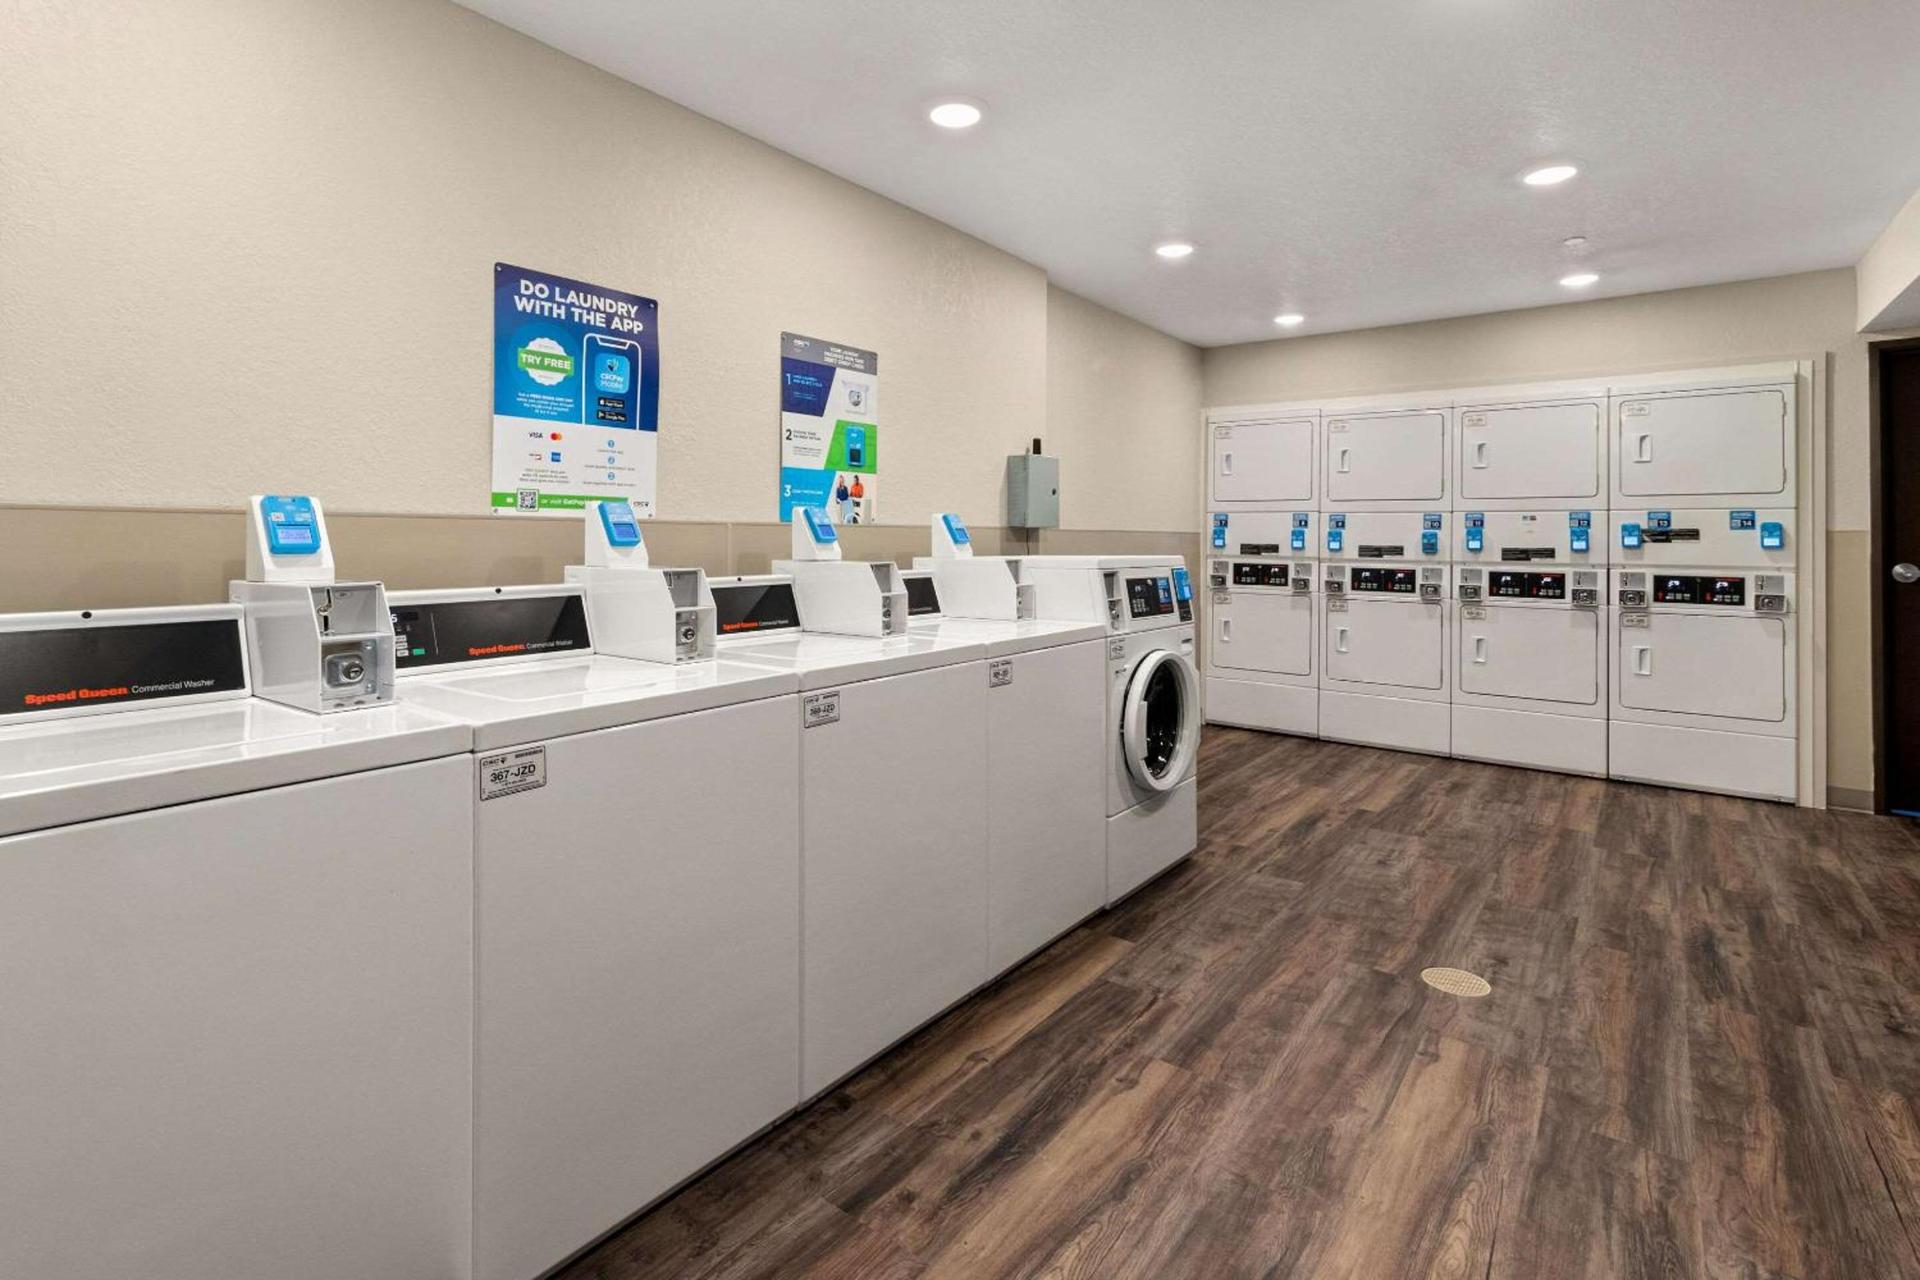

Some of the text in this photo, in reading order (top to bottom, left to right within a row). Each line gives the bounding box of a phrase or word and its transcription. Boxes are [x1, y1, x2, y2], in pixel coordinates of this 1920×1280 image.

[520, 279, 638, 318] DO LAUNDRY
[513, 295, 643, 334] WITH THE APP
[521, 353, 571, 369] TRY FREE
[786, 373, 792, 385] 1
[785, 429, 792, 440] 2
[784, 485, 792, 497] 3
[468, 645, 497, 656] Speed
[498, 643, 524, 652] Queen
[24, 678, 215, 705] Speed Queen Commercial Washer
[490, 764, 536, 782] 367-JZD
